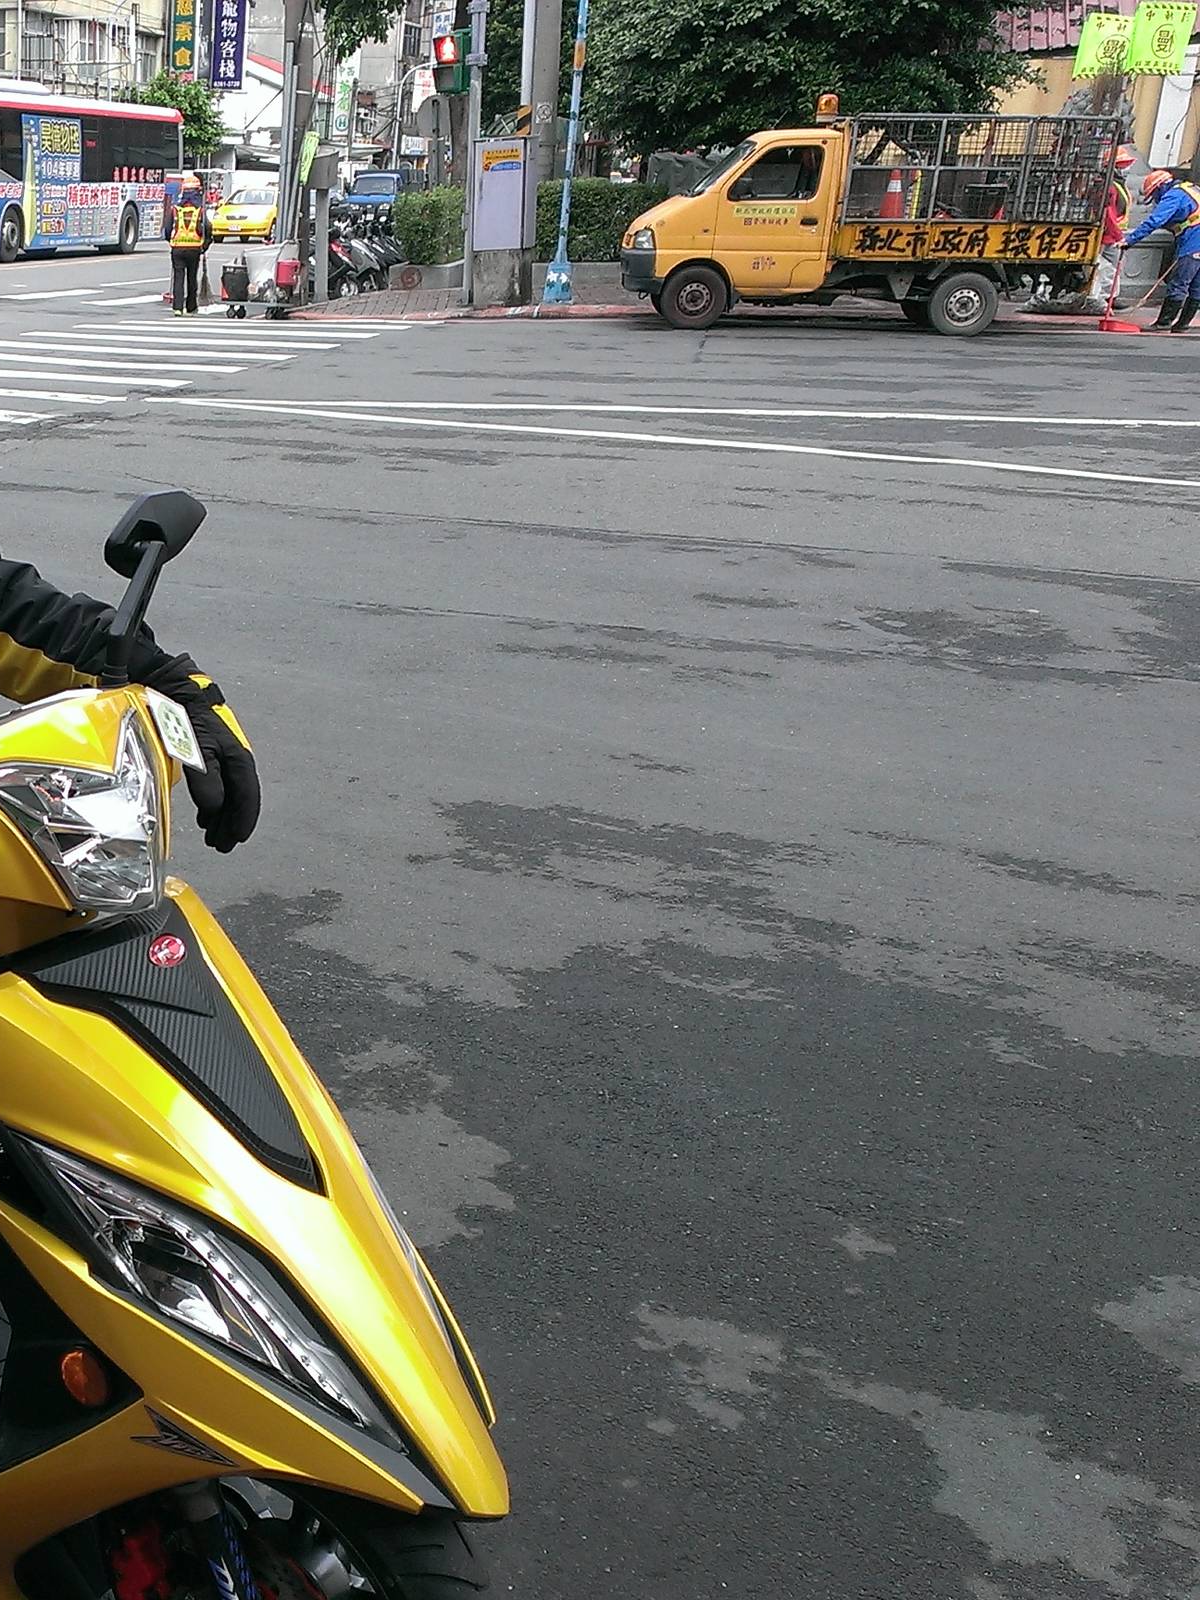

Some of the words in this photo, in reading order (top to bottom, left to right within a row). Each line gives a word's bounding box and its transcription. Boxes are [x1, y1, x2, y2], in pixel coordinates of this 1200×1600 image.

[855, 224, 1090, 259] 新北市政府環保局
